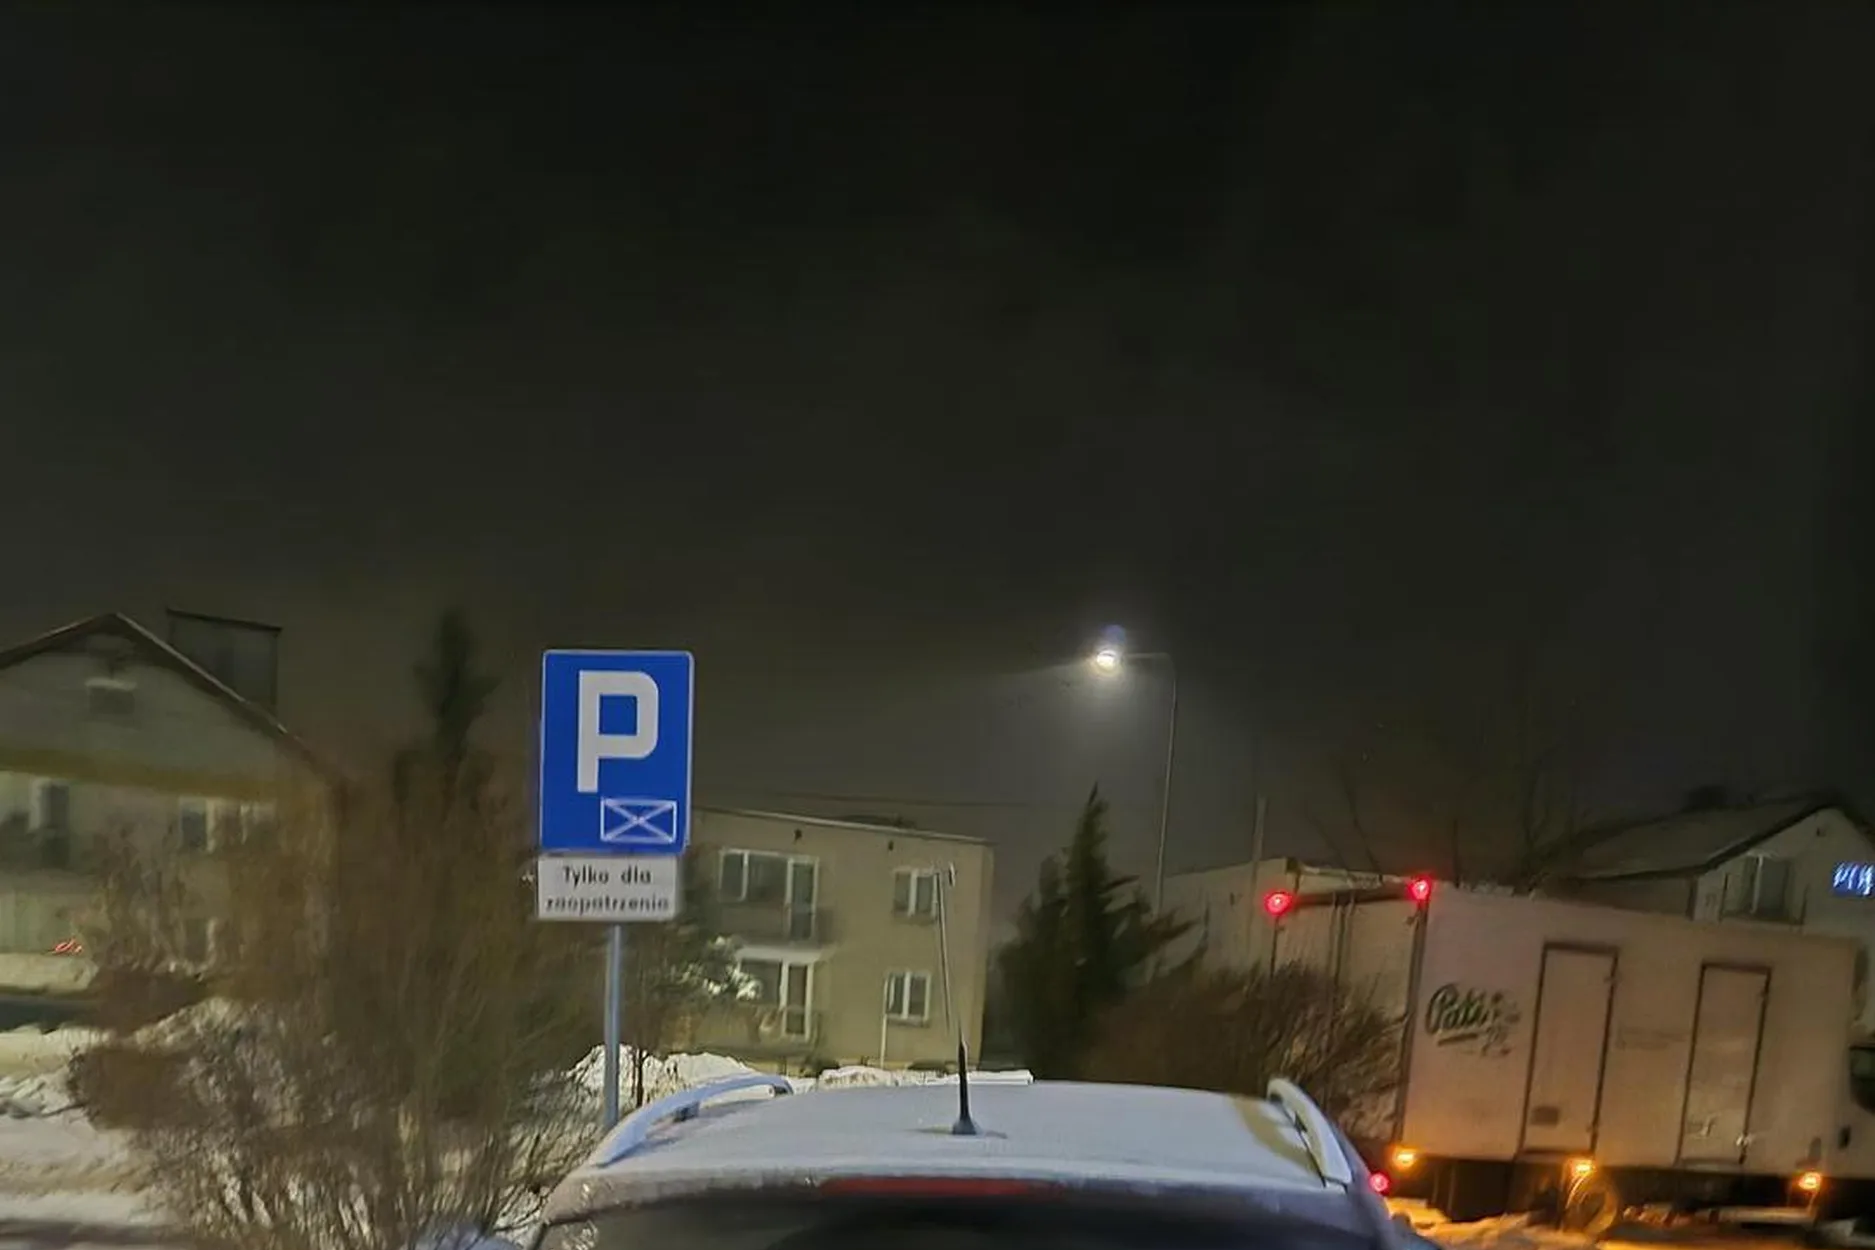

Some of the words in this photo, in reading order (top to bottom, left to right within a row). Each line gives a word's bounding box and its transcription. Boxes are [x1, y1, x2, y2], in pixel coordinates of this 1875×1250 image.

[577, 670, 659, 793] P
[562, 864, 609, 888] Tylko
[620, 864, 652, 885] dla
